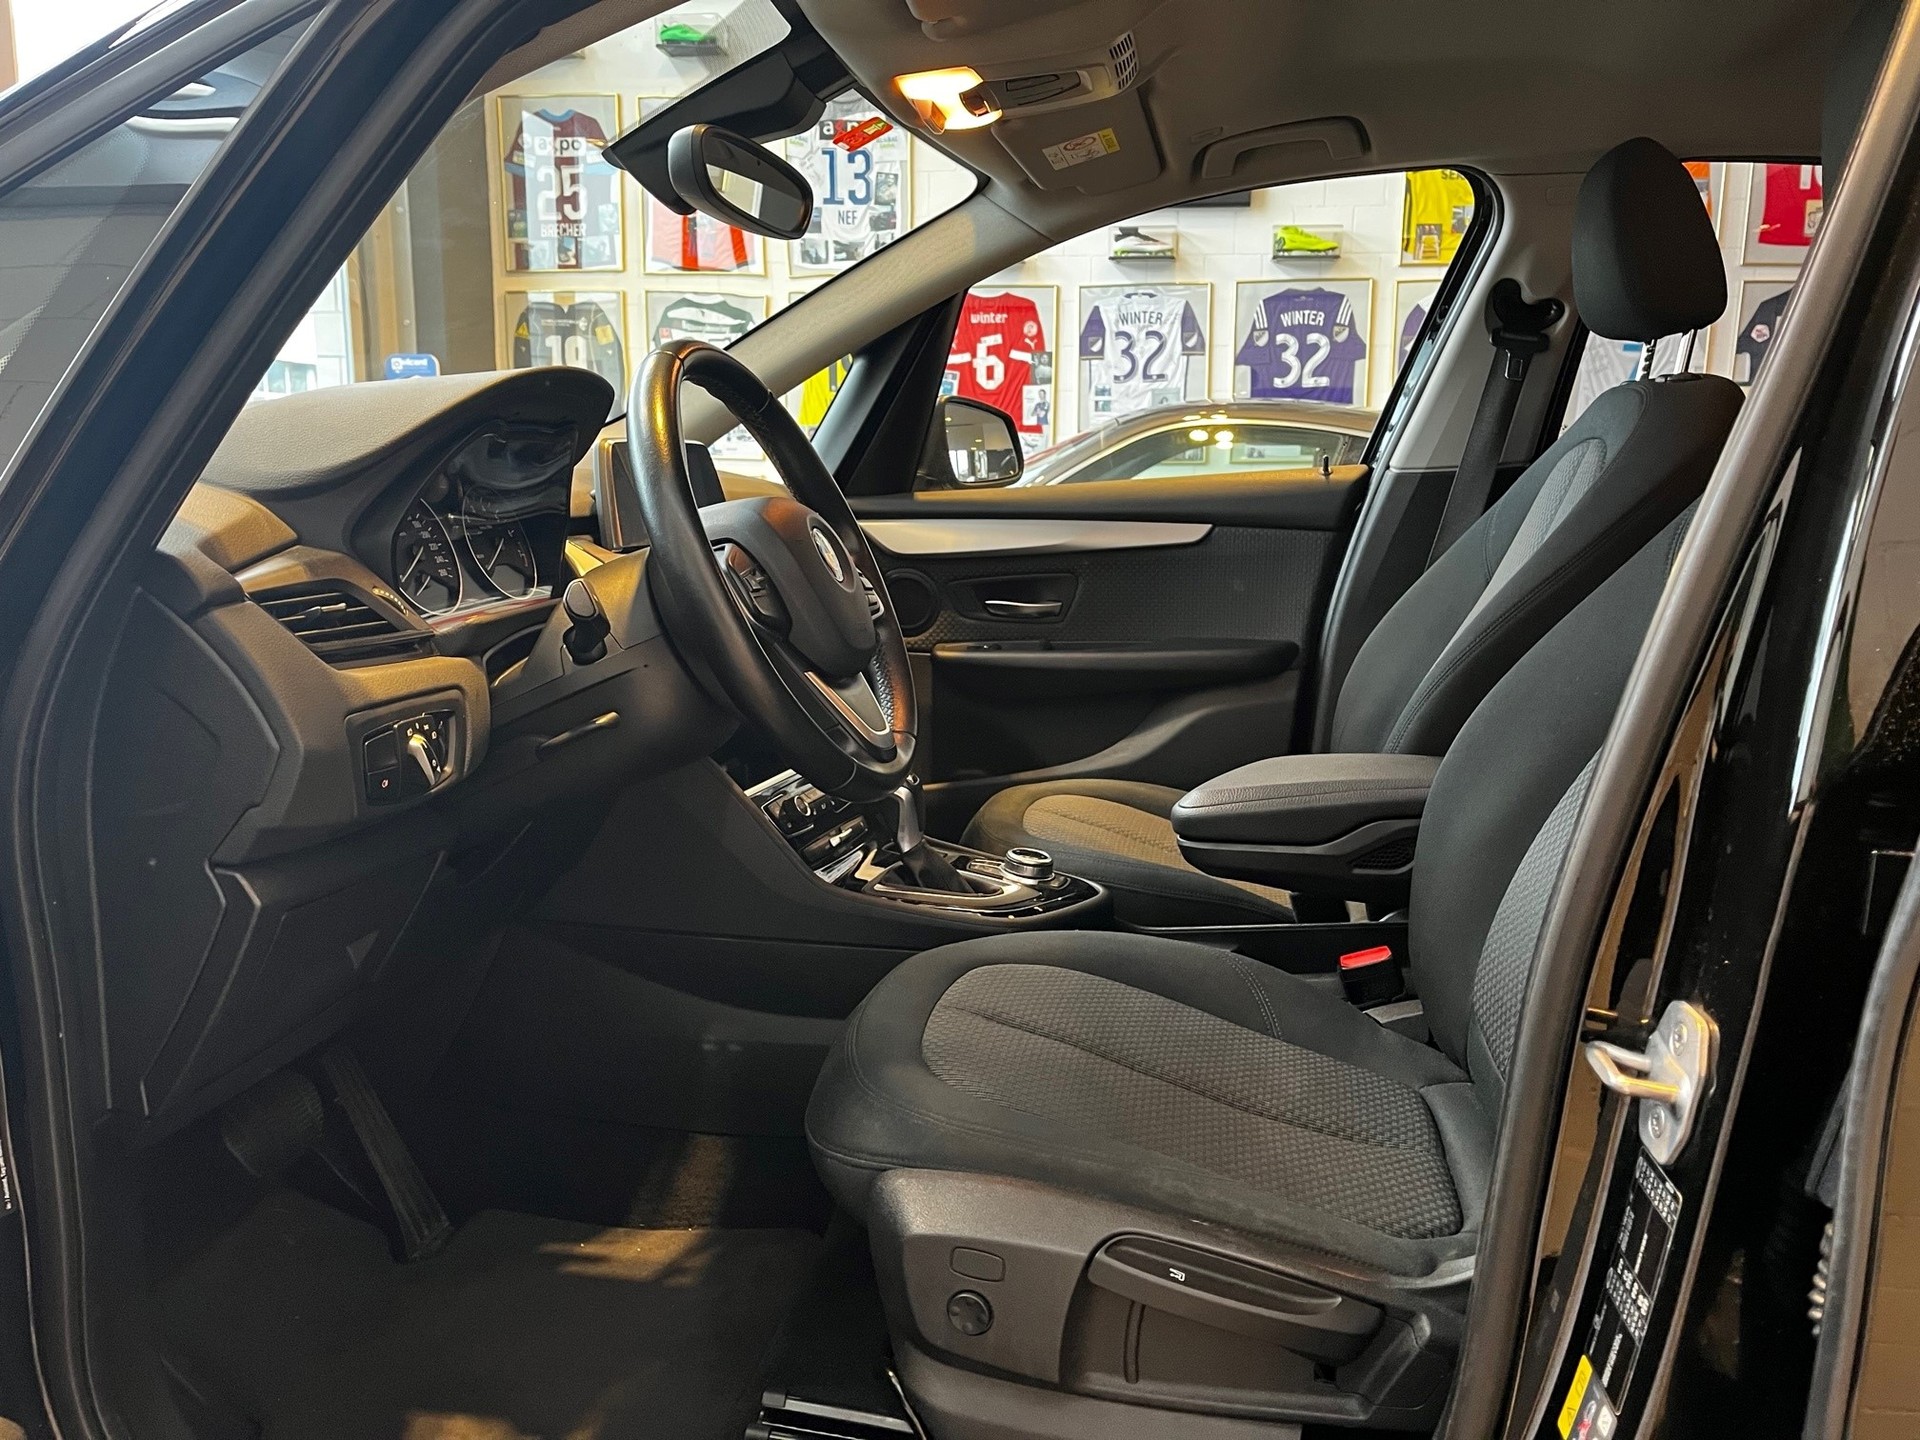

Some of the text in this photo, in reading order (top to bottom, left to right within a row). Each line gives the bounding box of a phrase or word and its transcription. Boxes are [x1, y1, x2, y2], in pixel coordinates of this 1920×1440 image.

[536, 164, 587, 220] 25
[821, 148, 875, 205] 13
[540, 223, 586, 237] BRECHER
[838, 210, 858, 225] NEF
[970, 311, 1008, 325] winter
[1118, 310, 1163, 326] WINTER
[1280, 310, 1325, 328] WINTER
[972, 334, 1005, 390] 6
[1113, 330, 1168, 384] 32
[1272, 332, 1331, 388] 32
